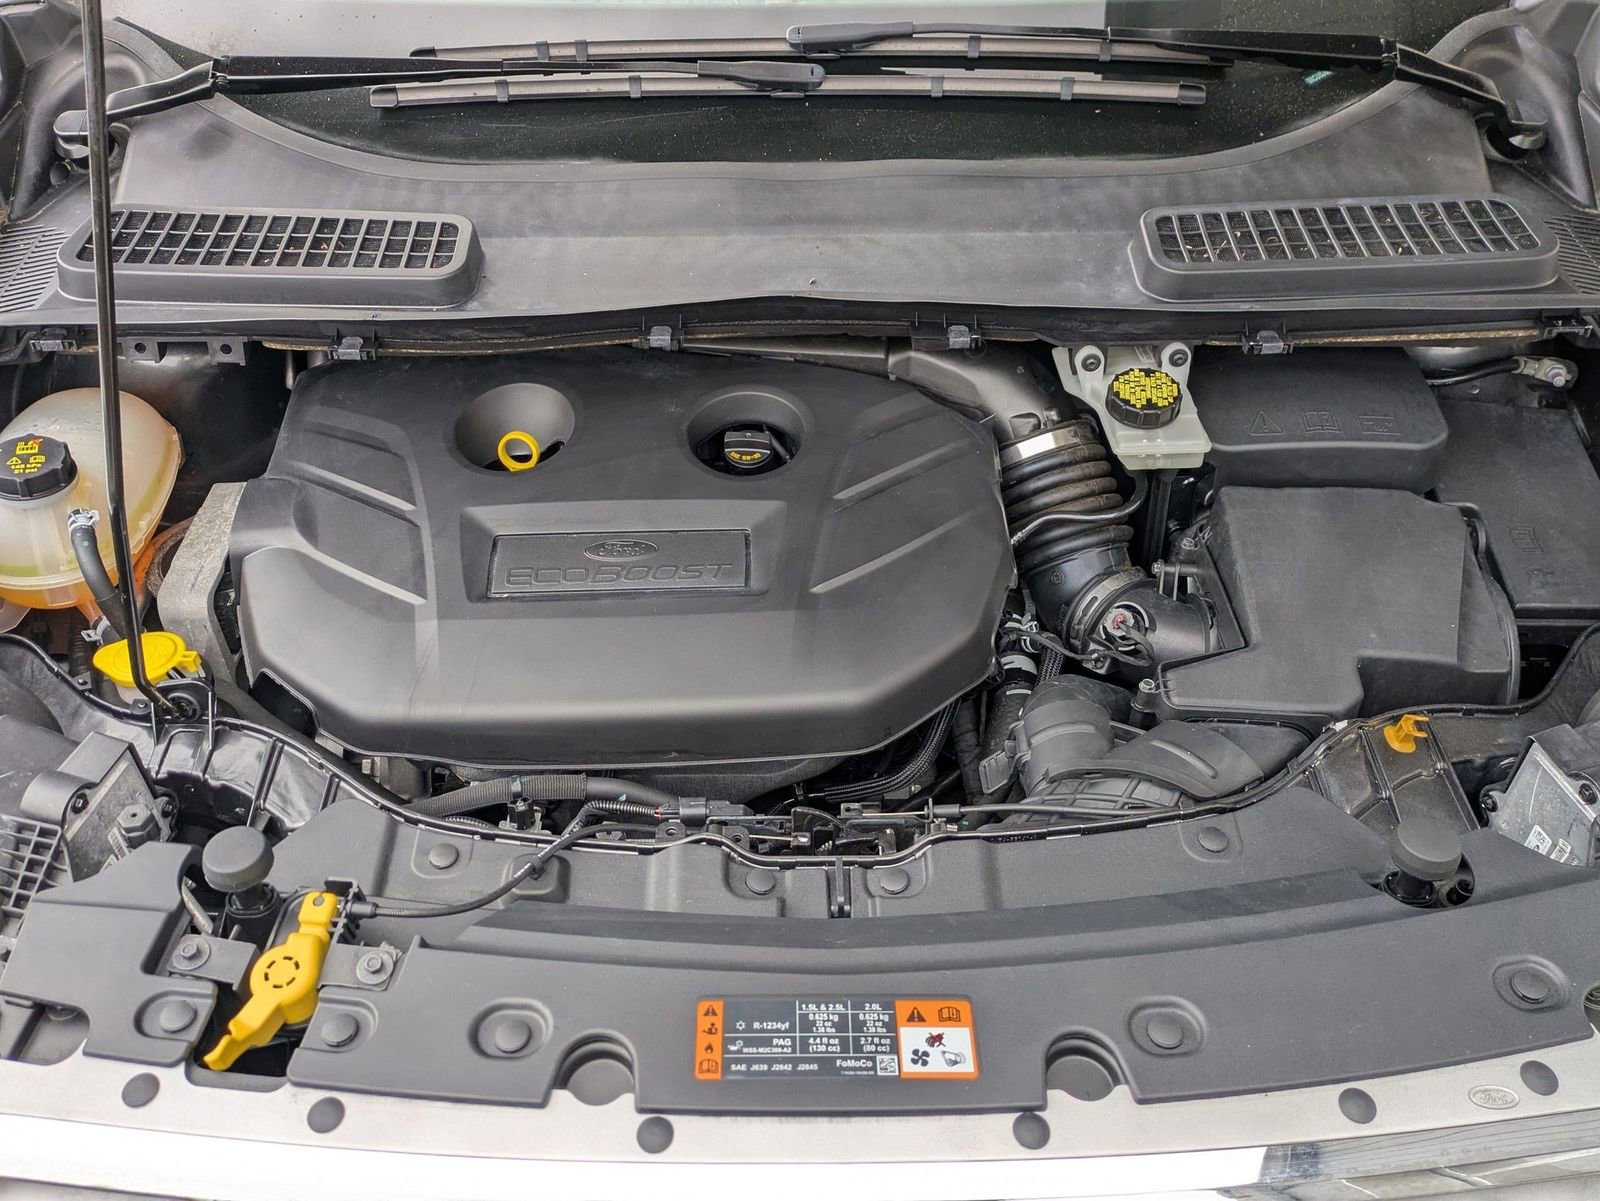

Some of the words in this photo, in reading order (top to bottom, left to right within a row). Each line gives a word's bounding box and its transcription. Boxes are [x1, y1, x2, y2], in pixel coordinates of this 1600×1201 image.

[505, 564, 733, 586] ECOBOOST
[802, 1003, 818, 1011] 1.5L
[820, 1003, 826, 1011] &
[828, 1003, 845, 1011] 2.5L
[865, 1003, 882, 1011] 2.0L
[808, 1013, 828, 1021] 0.625
[829, 1013, 839, 1022] kg
[859, 1013, 878, 1021] 0.625
[880, 1013, 889, 1022] kg
[753, 1022, 790, 1031] R-1234yf
[808, 1037, 821, 1045] 4.4
[822, 1037, 828, 1045] fl
[860, 1037, 872, 1045] 2.7
[873, 1037, 880, 1045] fl
[809, 1045, 826, 1053] (130
[828, 1045, 840, 1053] cc)
[863, 1045, 876, 1053] (80
[877, 1045, 890, 1053] cc)
[836, 1059, 873, 1068] FoMoCo
